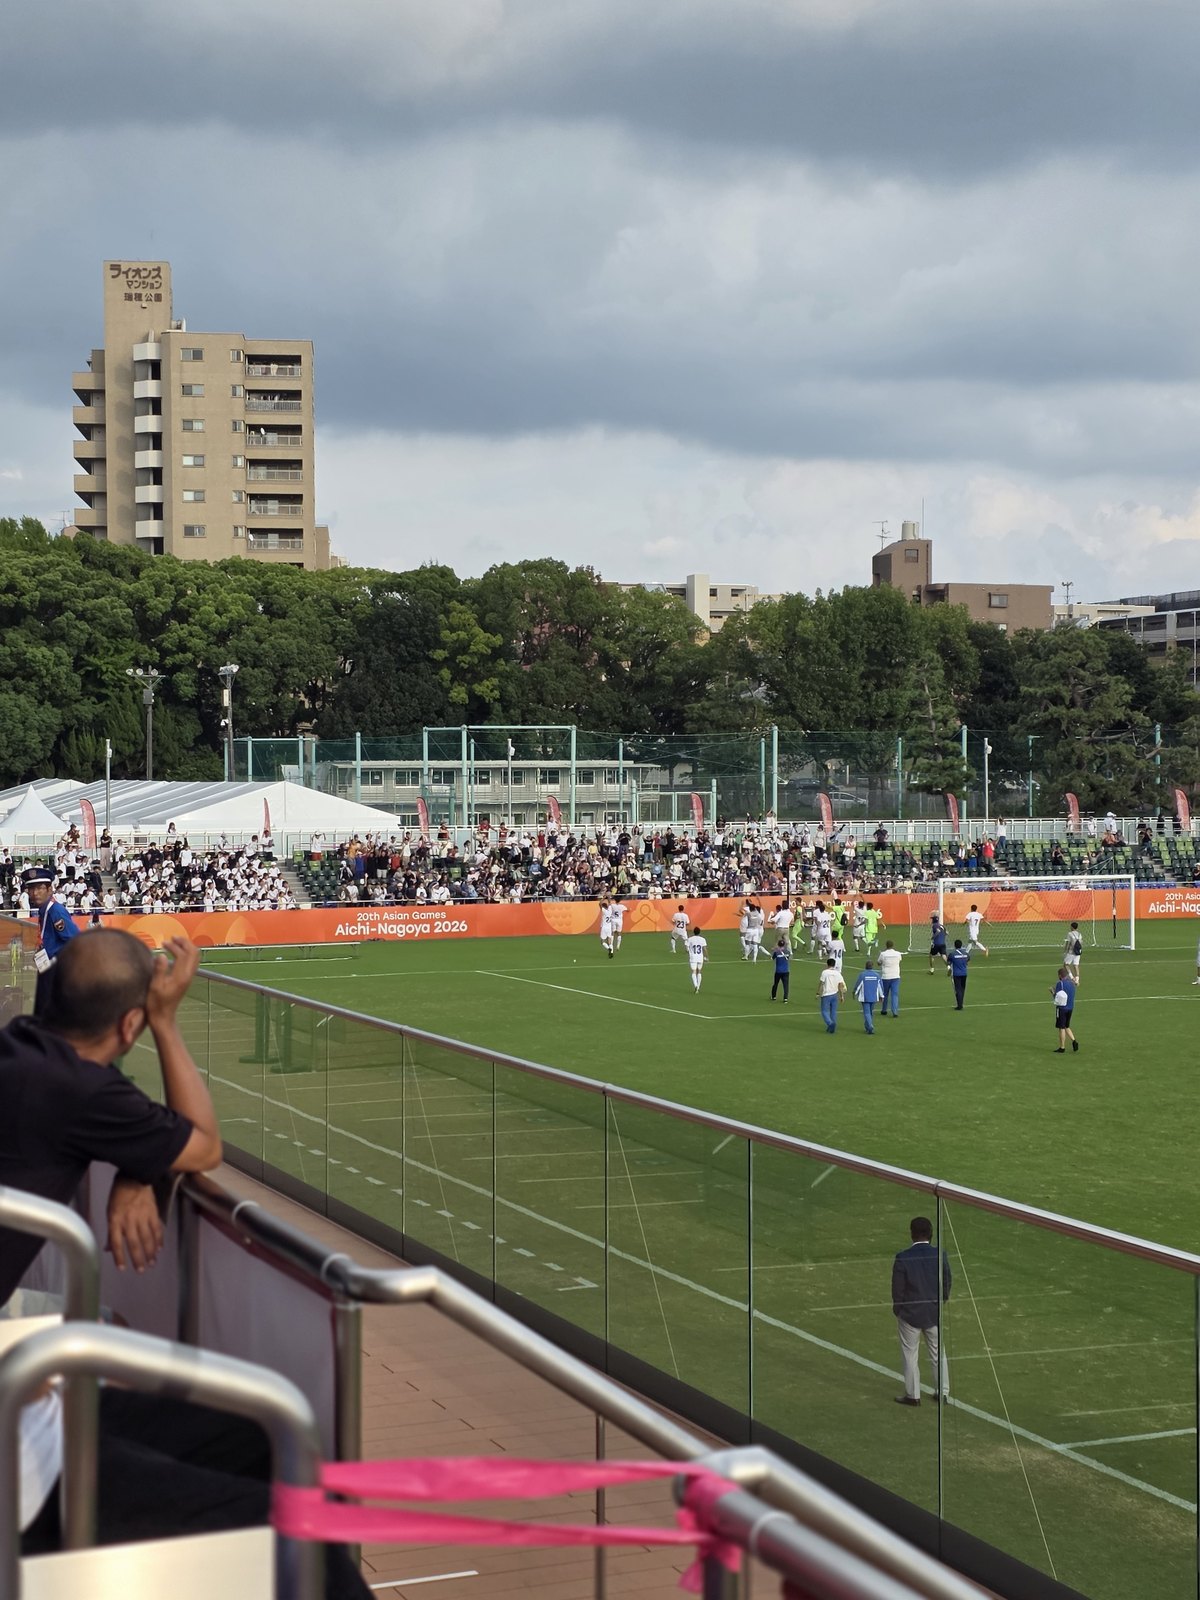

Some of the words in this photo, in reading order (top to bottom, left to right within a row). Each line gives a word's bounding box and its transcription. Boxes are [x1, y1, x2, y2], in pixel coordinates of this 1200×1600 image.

[110, 264, 162, 280] ライオンズ
[126, 280, 162, 290] マンション
[357, 912, 380, 922] 20th
[382, 912, 409, 920] Asian
[412, 910, 446, 920] Games
[335, 922, 430, 937] Aichi-Nagoya
[434, 920, 468, 933] 2026
[676, 920, 684, 929] 23
[692, 944, 701, 954] 13
